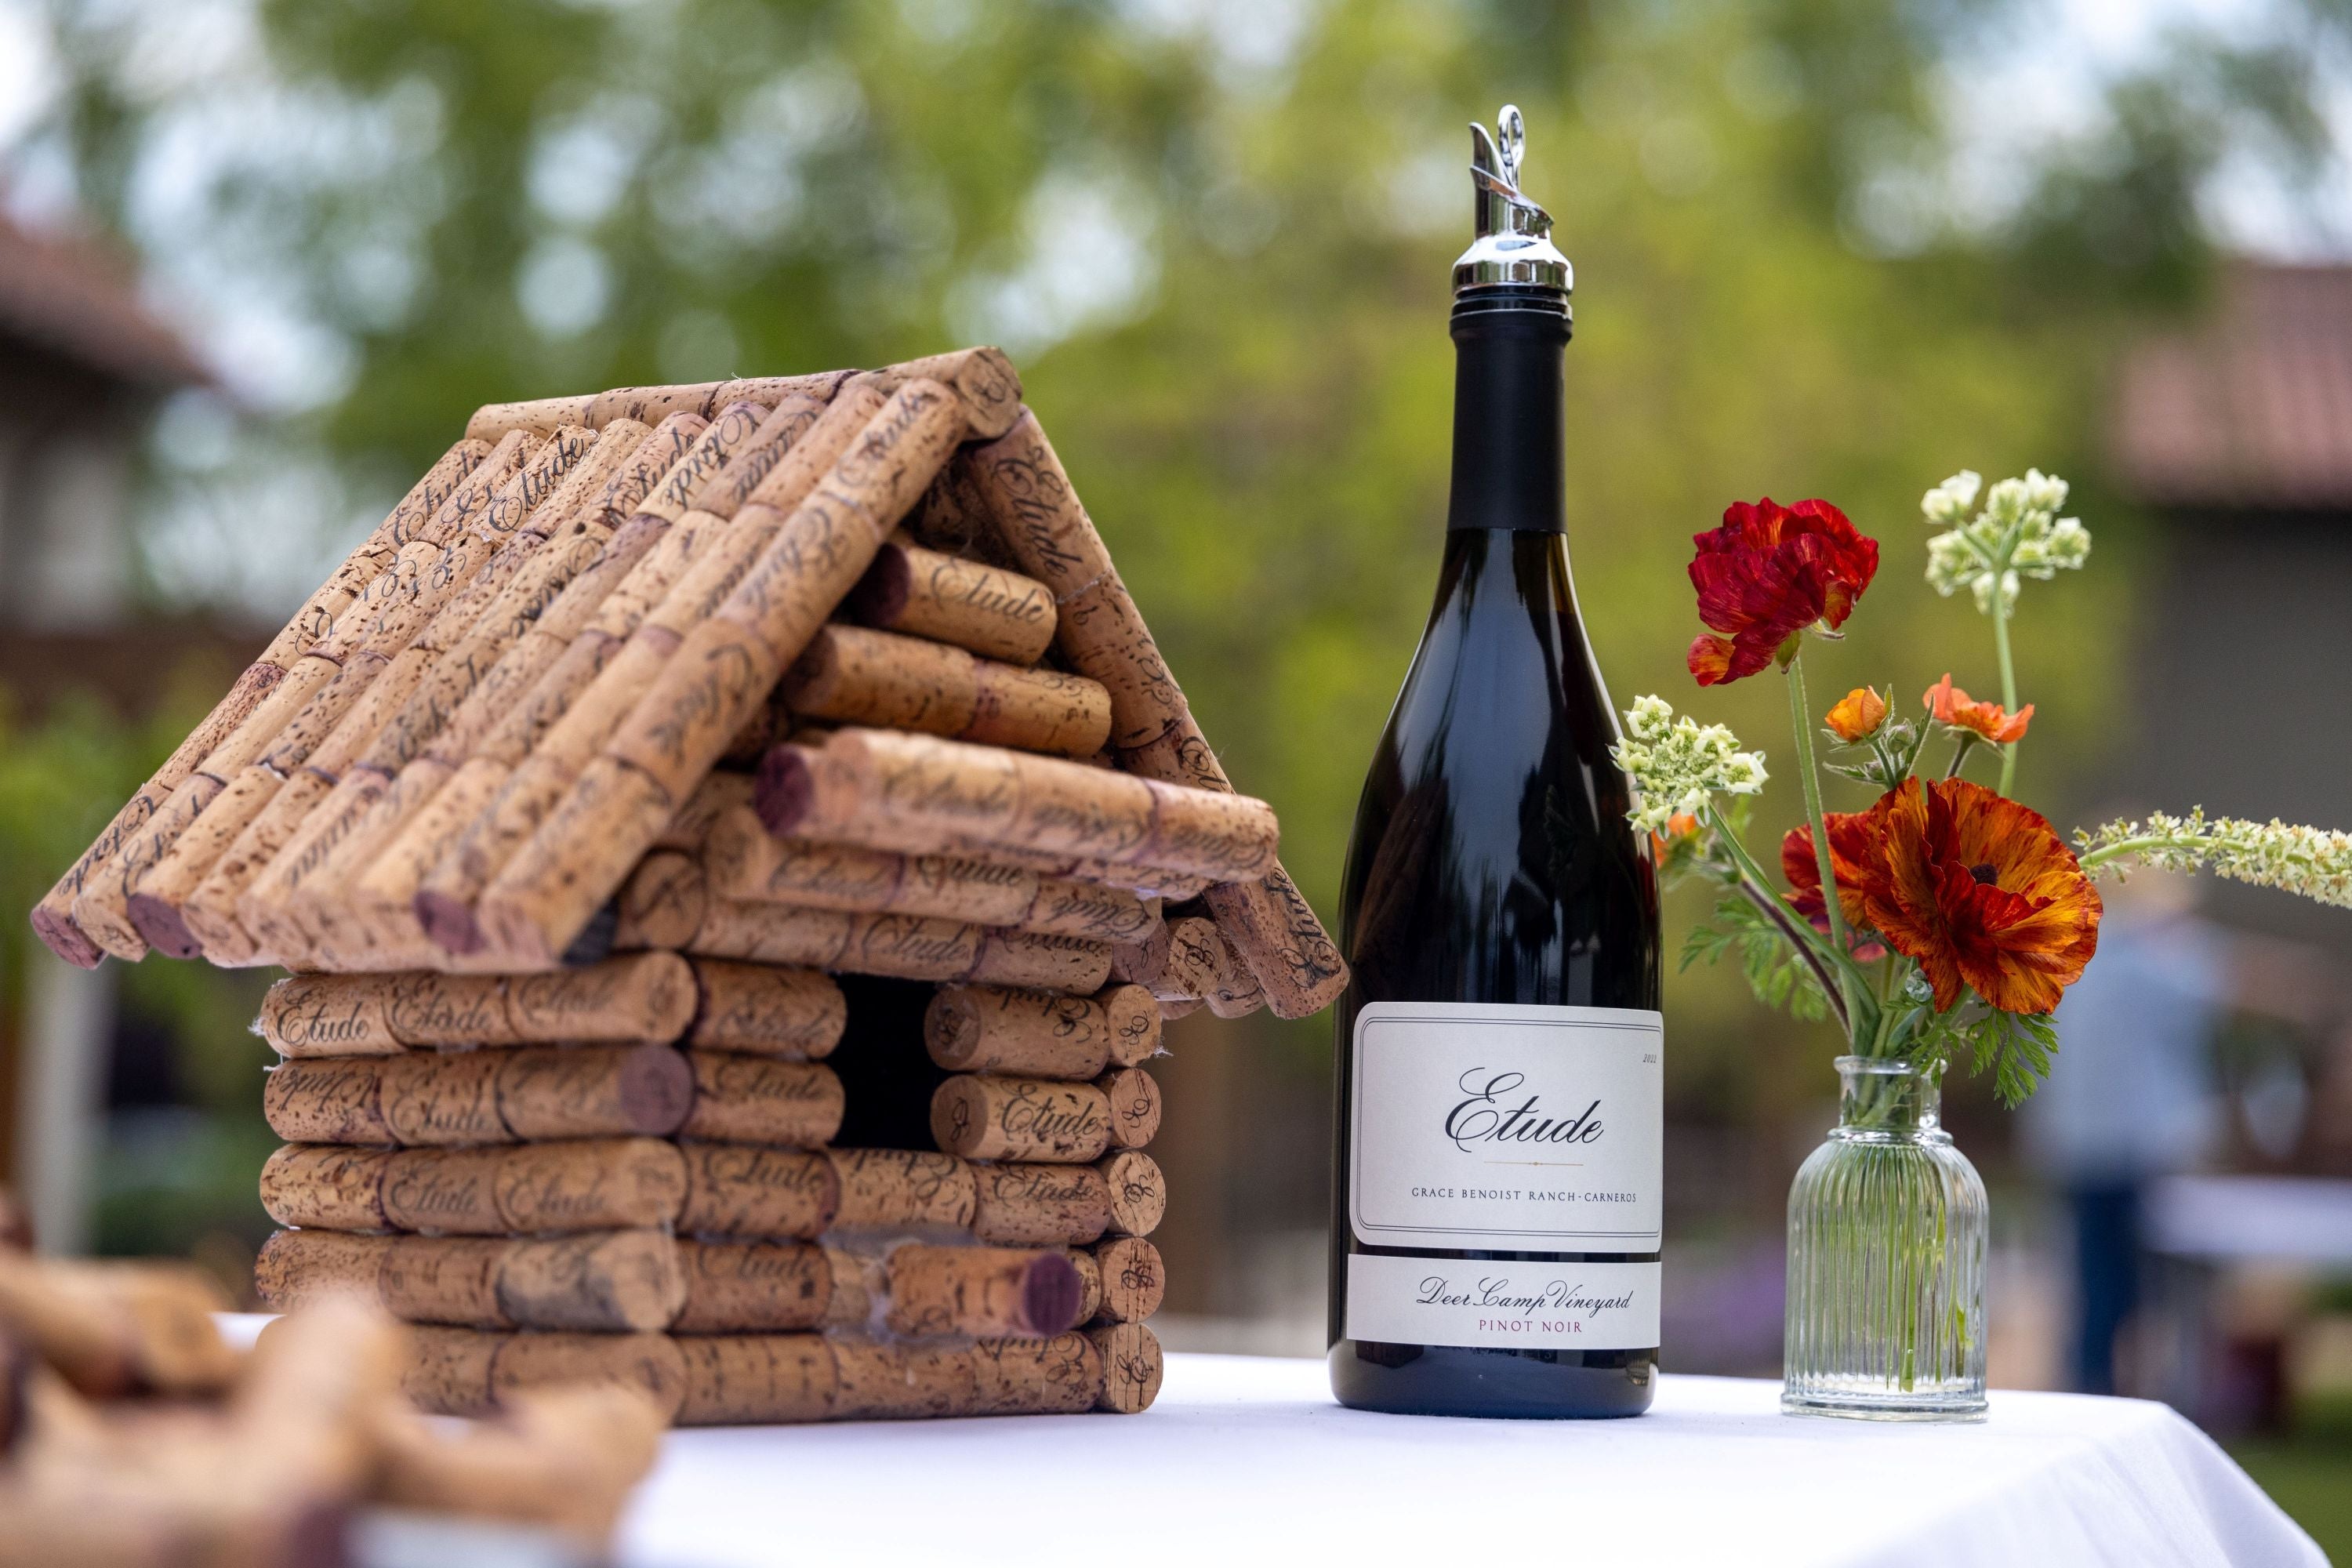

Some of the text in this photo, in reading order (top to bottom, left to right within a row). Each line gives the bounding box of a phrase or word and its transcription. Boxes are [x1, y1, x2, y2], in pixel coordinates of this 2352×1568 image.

[488, 437, 585, 533] Etude
[991, 445, 1083, 578] Etude
[931, 554, 1047, 624] Etude
[58, 795, 155, 897] Etude
[1260, 866, 1342, 990] Etude
[278, 985, 369, 1047] Etude
[1000, 1080, 1099, 1142] Etude
[1445, 1067, 1605, 1153] Etude
[1411, 1187, 1454, 1198] GRACE
[1461, 1189, 1522, 1200] BENOIST
[1416, 1276, 1634, 1319] Deer Camp Vineyard
[1479, 1319, 1582, 1333] PINOT NOIR
